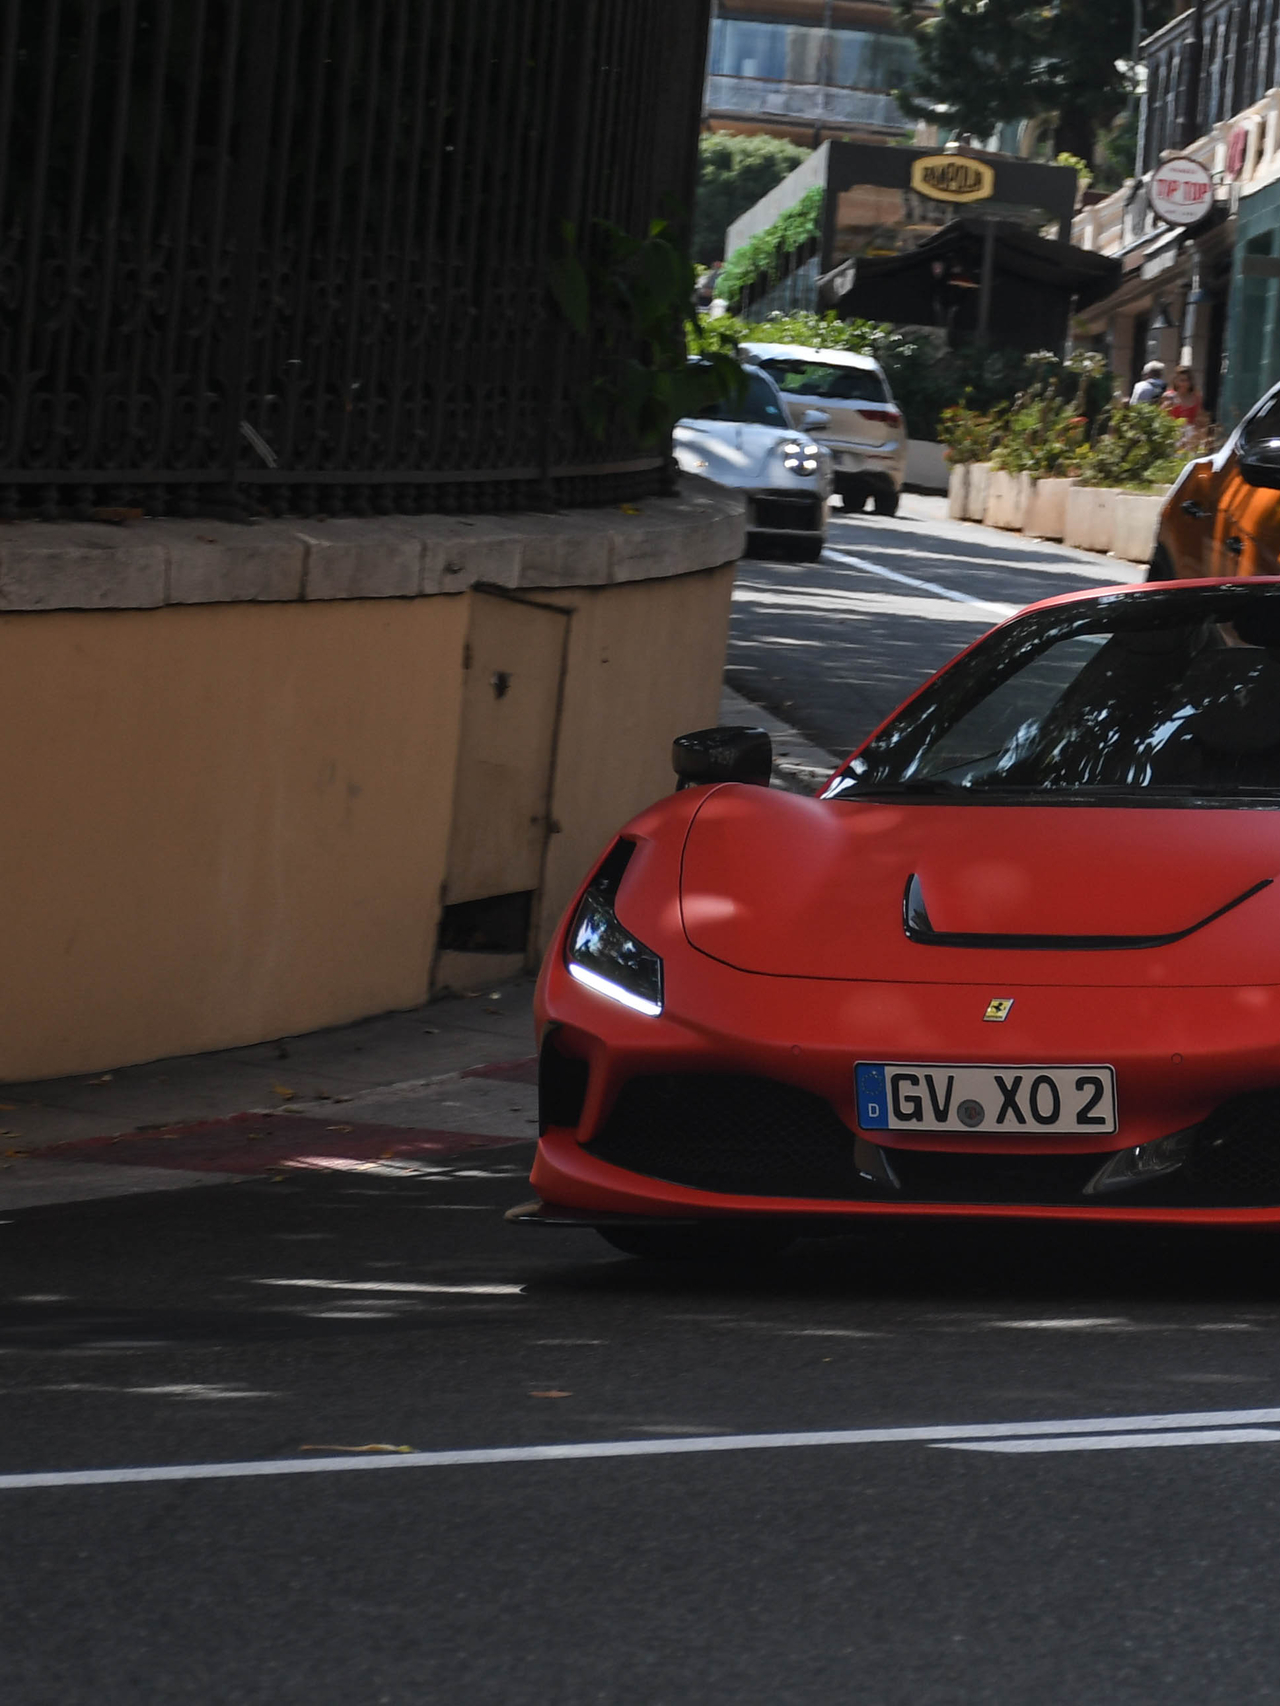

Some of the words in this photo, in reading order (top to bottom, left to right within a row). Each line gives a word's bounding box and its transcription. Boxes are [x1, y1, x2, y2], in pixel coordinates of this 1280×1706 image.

[1156, 178, 1180, 198] TIP
[1183, 181, 1210, 202] TOP
[868, 1103, 880, 1118] D
[890, 1073, 954, 1123] GV
[1075, 1076, 1107, 1125] 2
